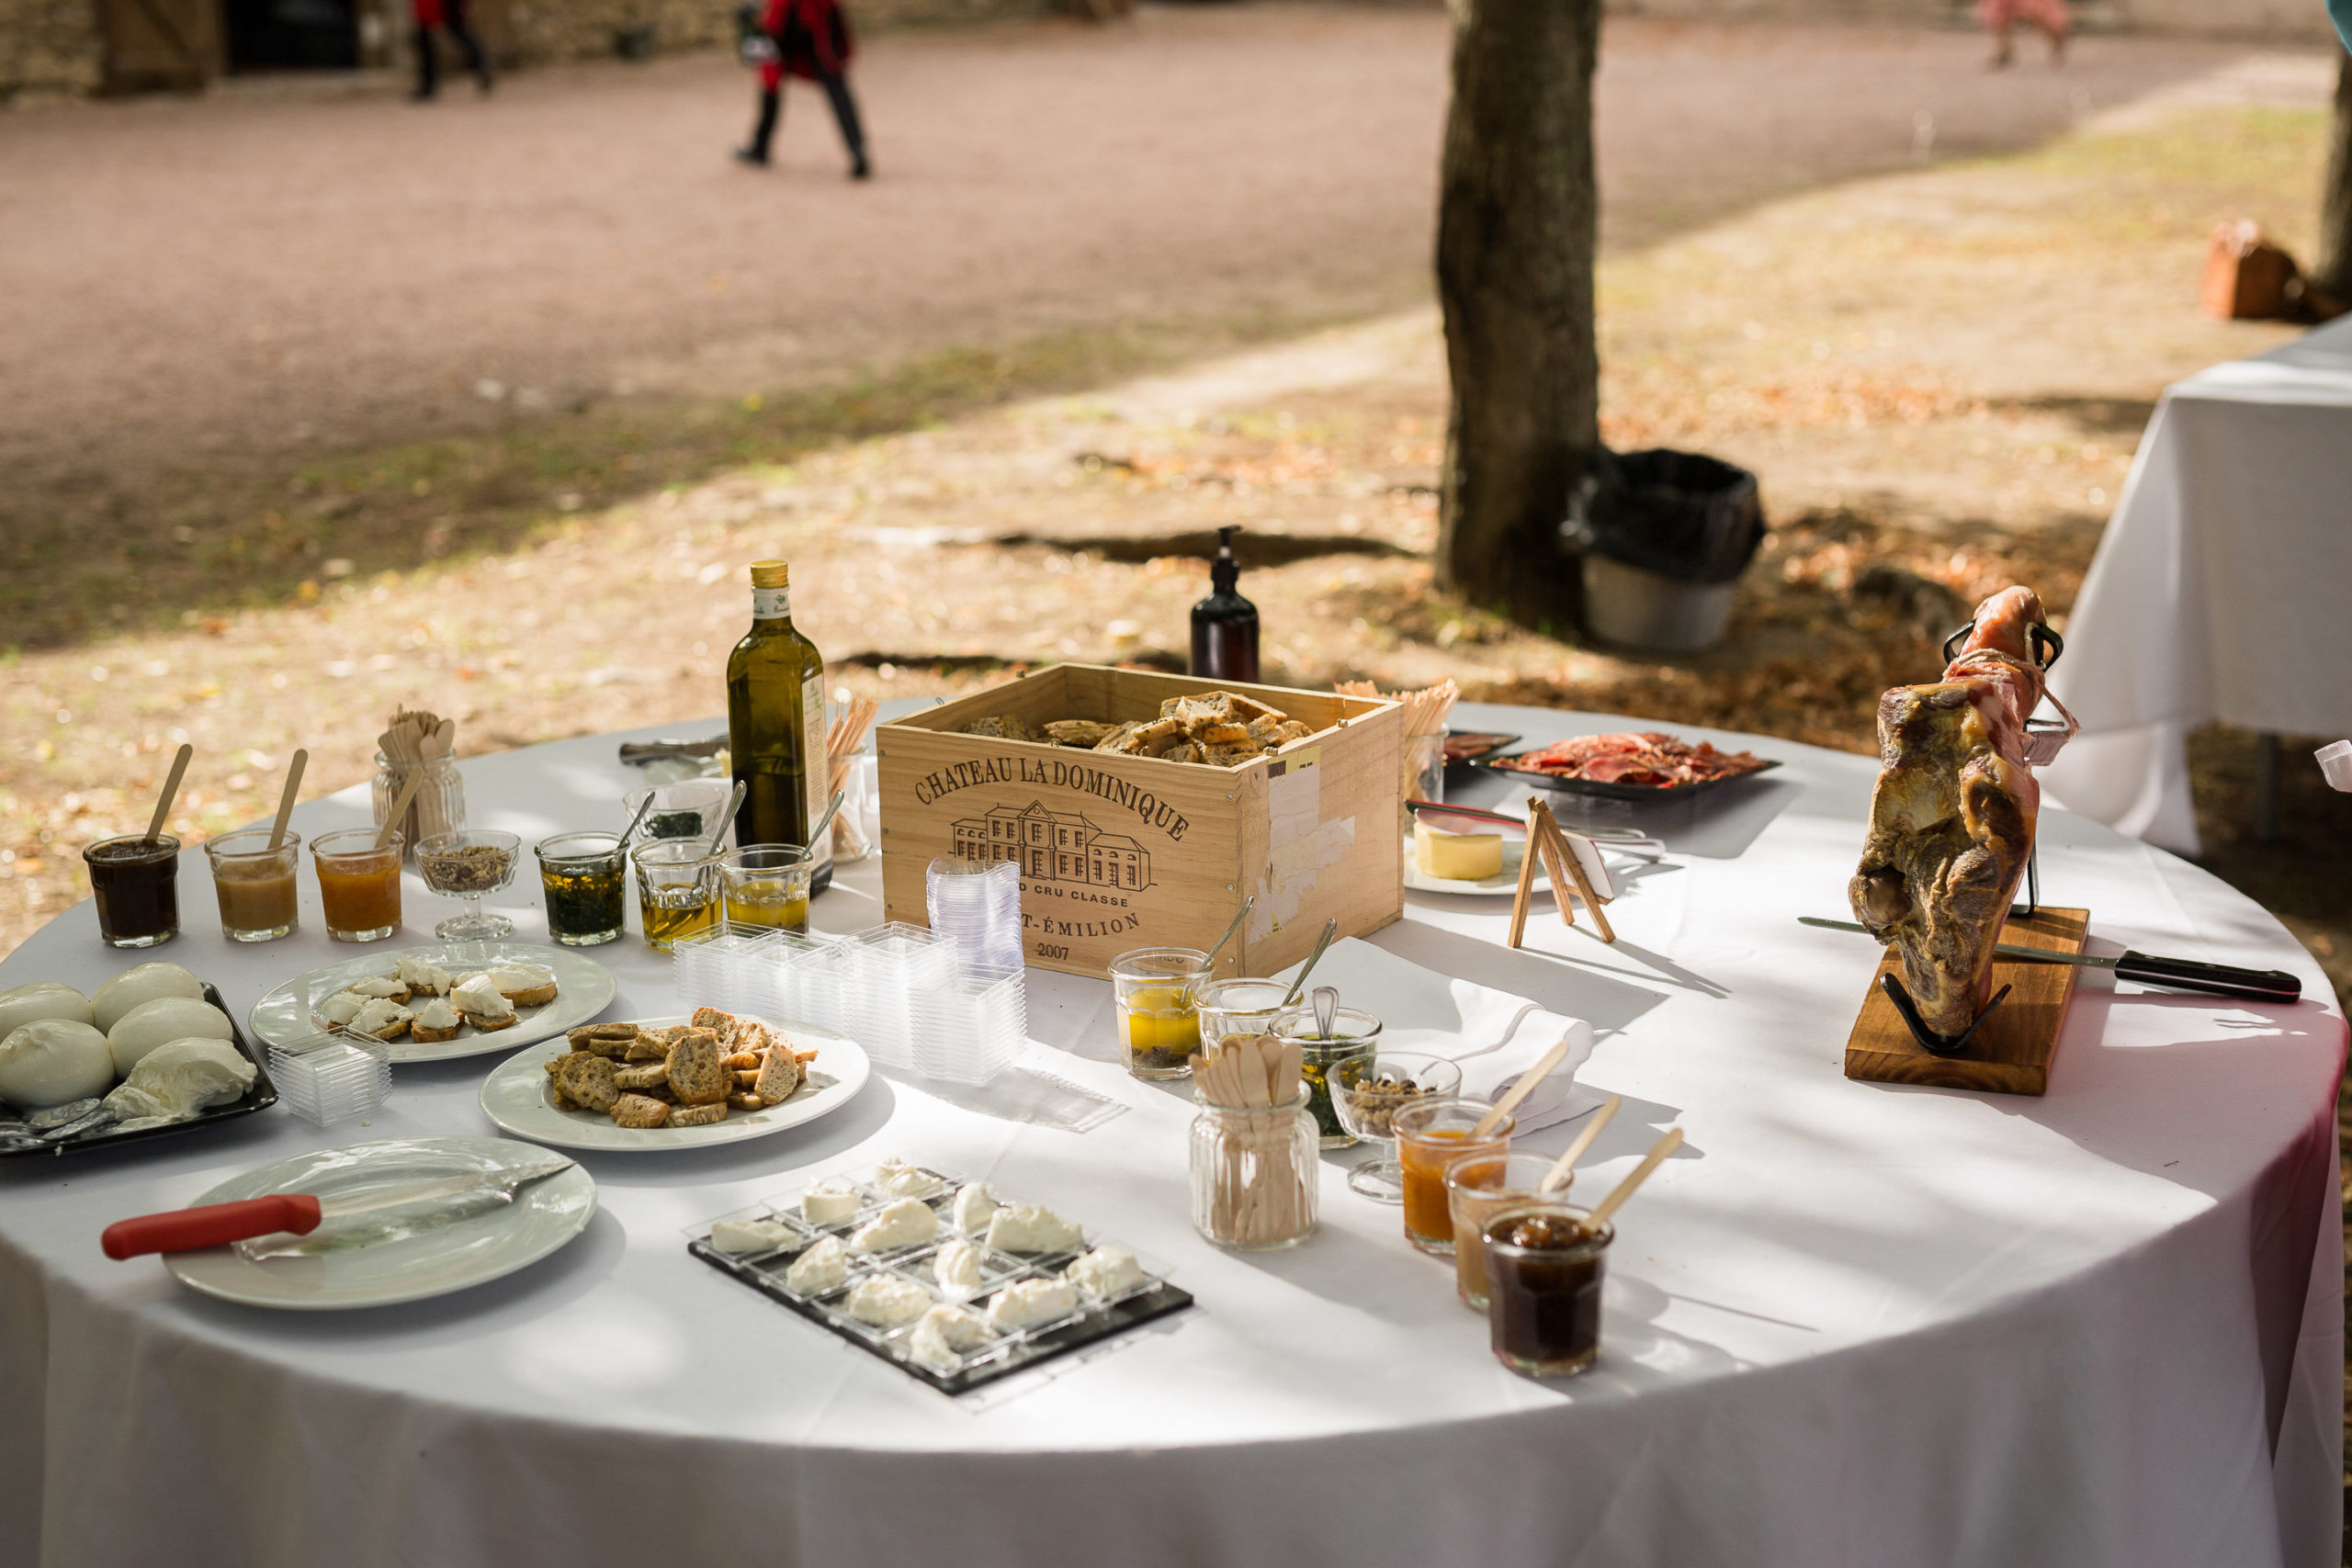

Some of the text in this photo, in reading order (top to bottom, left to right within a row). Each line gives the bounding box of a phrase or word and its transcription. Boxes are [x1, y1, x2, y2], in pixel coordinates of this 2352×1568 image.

[914, 757, 1191, 842] CHATEAU LA DOMINIQUE
[1034, 885, 1063, 897] CRU
[1070, 890, 1128, 908] CLASSE
[1021, 911, 1140, 937] T-ÉMILION
[1036, 942, 1069, 961] 2007
